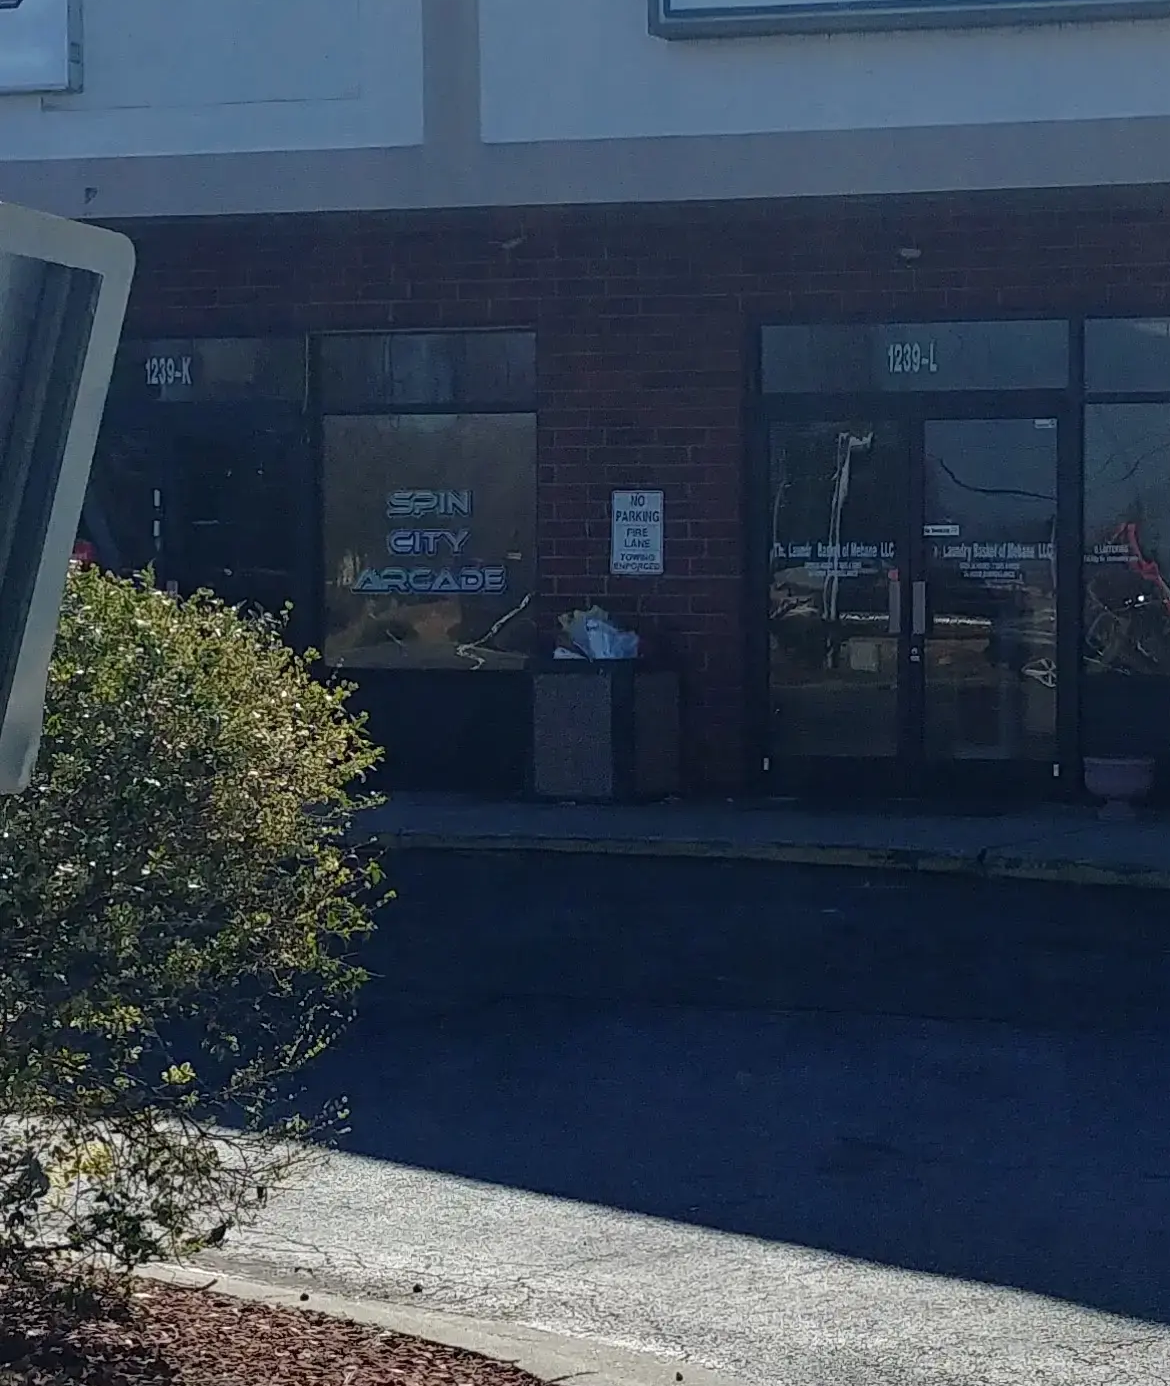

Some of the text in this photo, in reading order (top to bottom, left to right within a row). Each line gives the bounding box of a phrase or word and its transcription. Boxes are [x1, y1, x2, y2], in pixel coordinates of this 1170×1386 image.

[888, 342, 938, 373] 1239-L
[145, 356, 192, 385] 1239-K
[387, 489, 473, 518] SPIN
[630, 495, 646, 507] NO
[615, 510, 660, 522] PARKING
[626, 528, 649, 538] FIRE
[387, 528, 471, 556] CITY
[624, 539, 651, 549] LANE
[788, 542, 813, 558] Laundr
[880, 542, 895, 558] LLC
[1038, 543, 1054, 559] LLC
[350, 565, 507, 595] ARCADE
